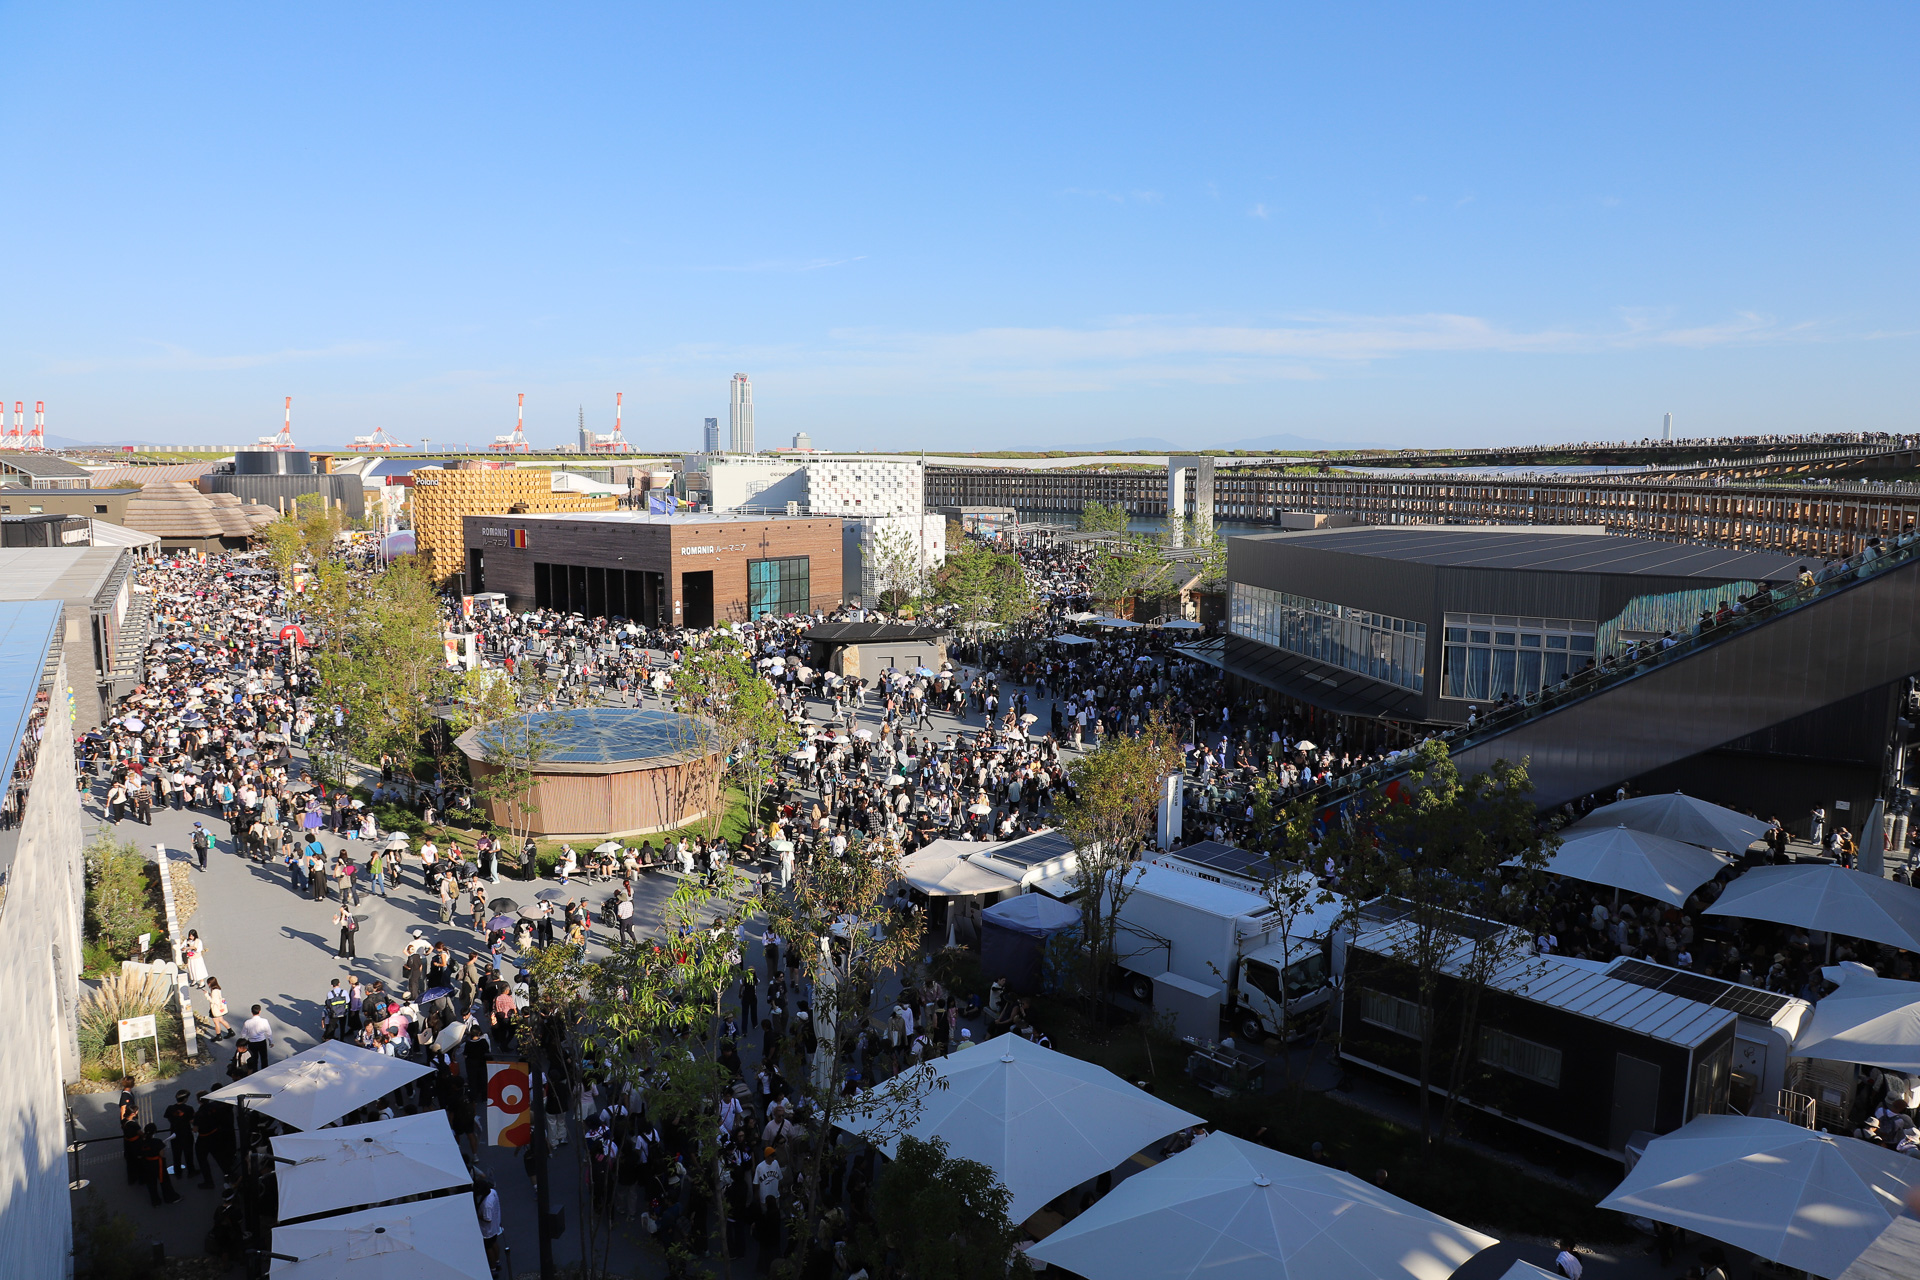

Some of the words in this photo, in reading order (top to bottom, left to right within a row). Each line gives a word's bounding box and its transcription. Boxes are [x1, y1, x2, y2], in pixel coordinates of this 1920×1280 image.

[416, 476, 439, 486] Poland
[482, 527, 508, 537] ROMANIA
[483, 538, 508, 547] ルーマニア
[681, 545, 714, 556] ROMANIA
[715, 543, 747, 553] ルーマニア
[1176, 866, 1198, 877] CANAL
[1200, 872, 1218, 883] CAFE
